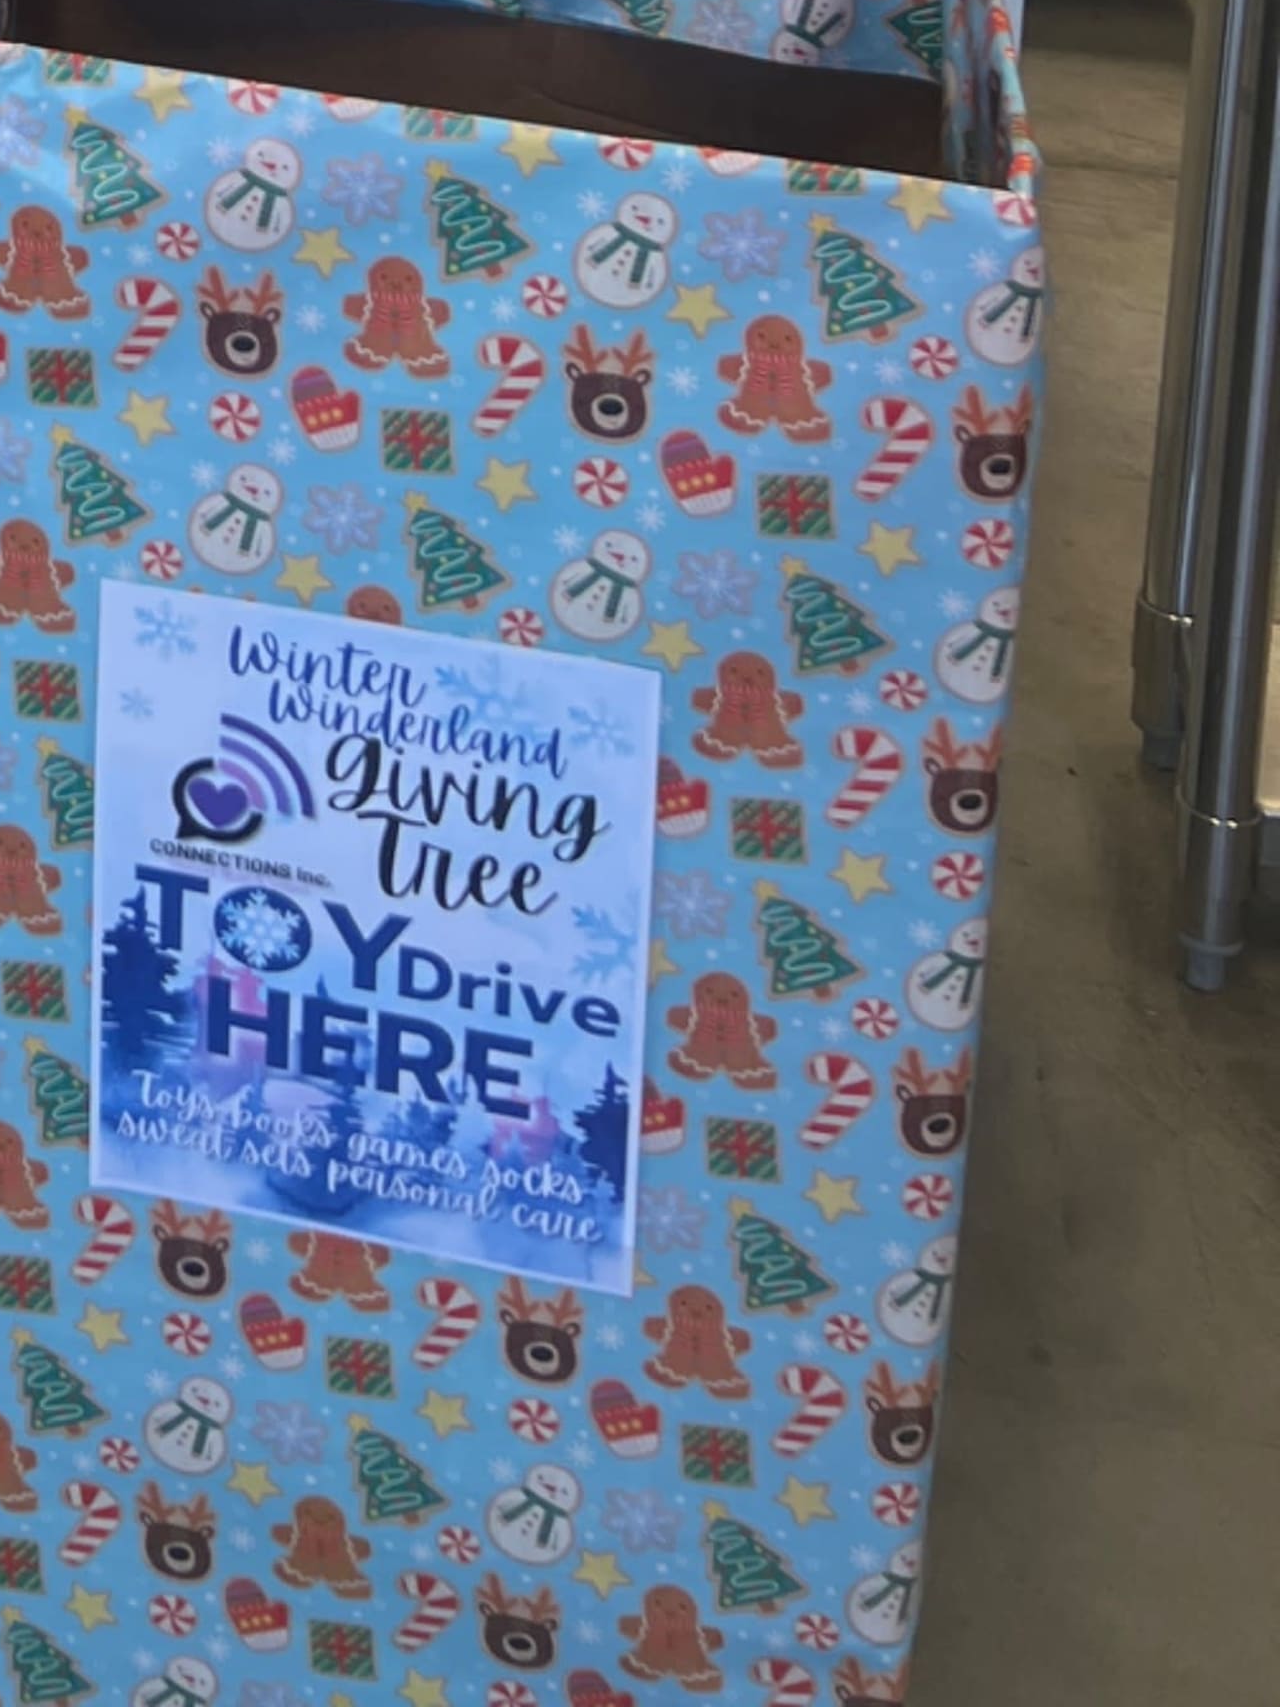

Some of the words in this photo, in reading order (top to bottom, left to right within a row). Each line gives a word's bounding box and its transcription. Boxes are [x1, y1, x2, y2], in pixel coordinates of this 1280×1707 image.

[228, 625, 428, 708] Winter
[149, 837, 292, 881] CONNECTIONS
[295, 865, 334, 888] Inc.
[356, 809, 559, 916] Tree
[207, 976, 534, 1121] HERE
[240, 1138, 313, 1179] sets
[327, 1158, 500, 1220] personal
[511, 1202, 603, 1243] care
[347, 1132, 467, 1179] games
[480, 1158, 584, 1205] socks
